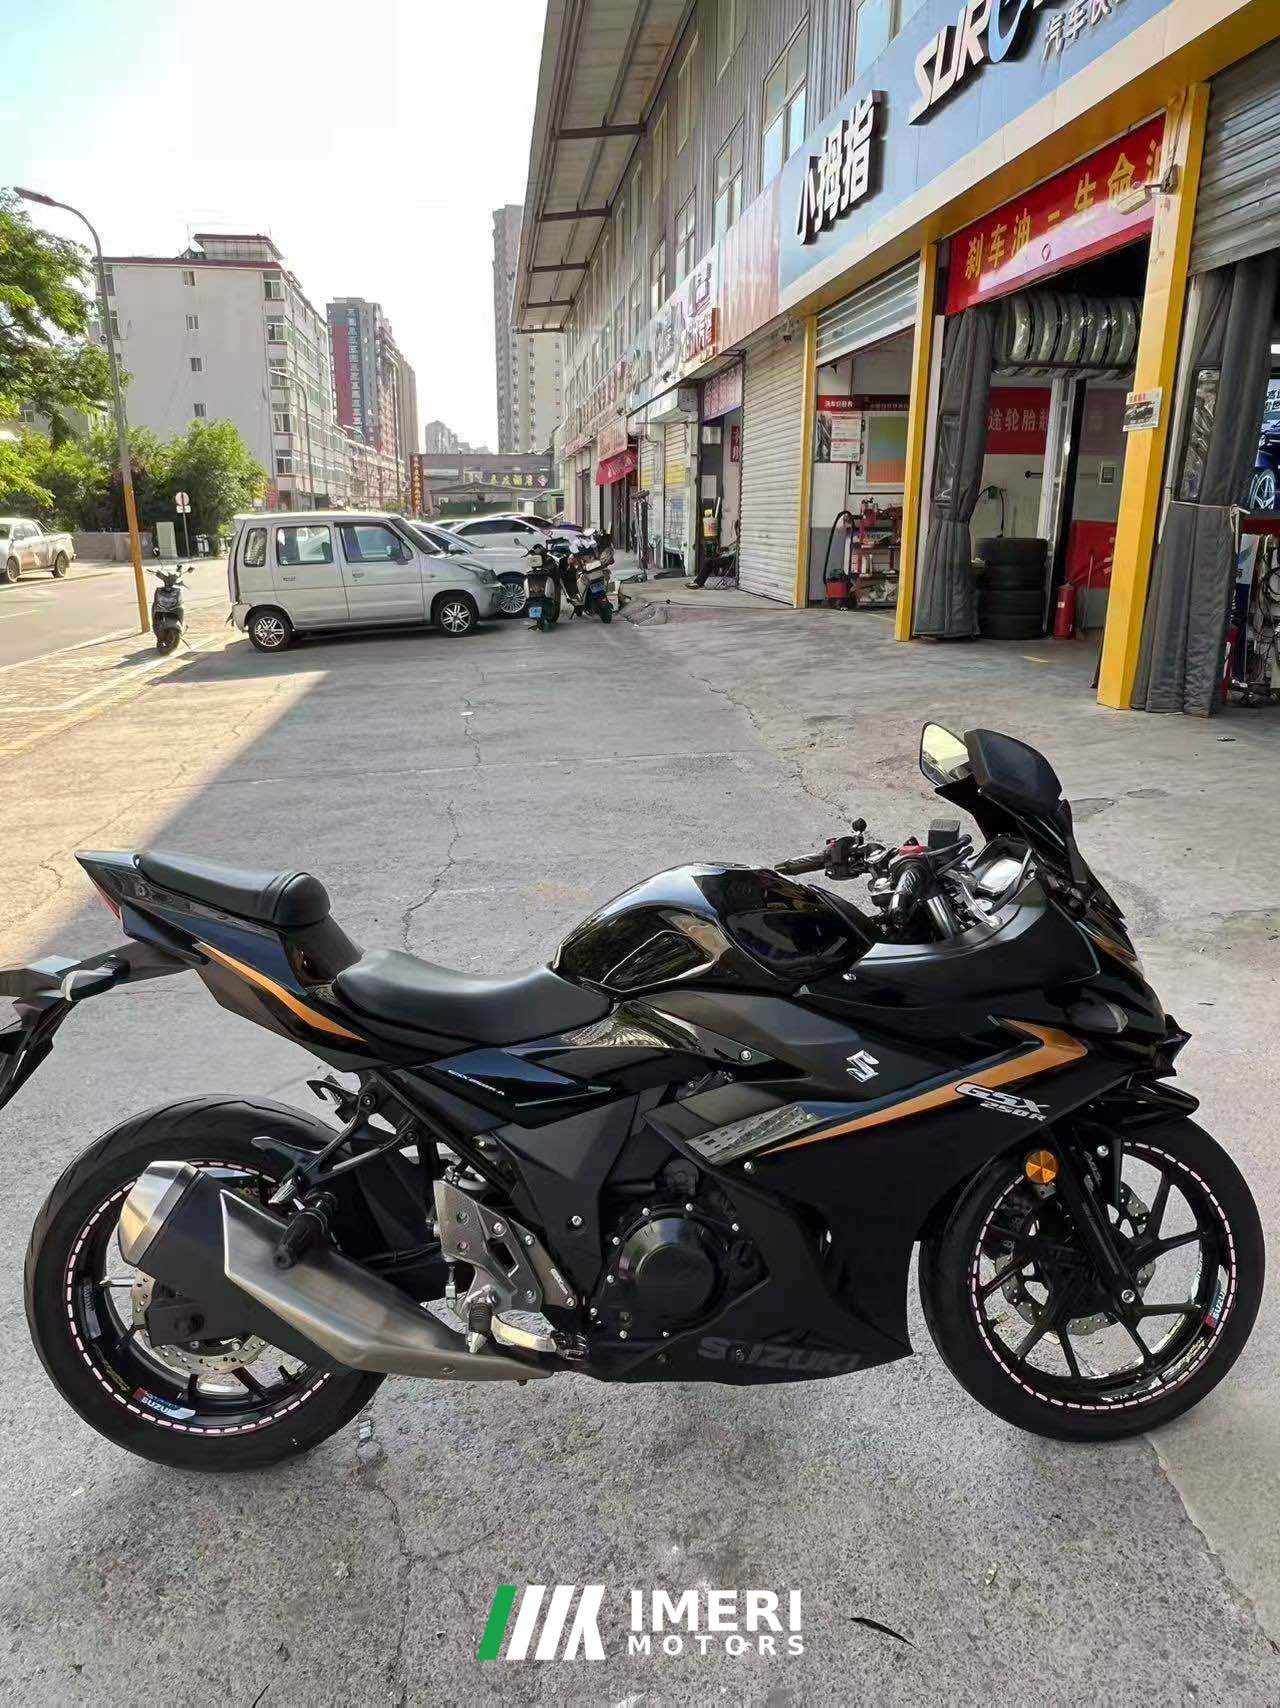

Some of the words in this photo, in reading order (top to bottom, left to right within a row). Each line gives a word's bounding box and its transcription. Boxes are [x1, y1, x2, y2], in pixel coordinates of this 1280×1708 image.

[797, 90, 877, 245] 小拇指
[955, 1082, 1050, 1113] GSX
[980, 1099, 1047, 1121] 250R
[697, 1336, 863, 1372] SUZUKI
